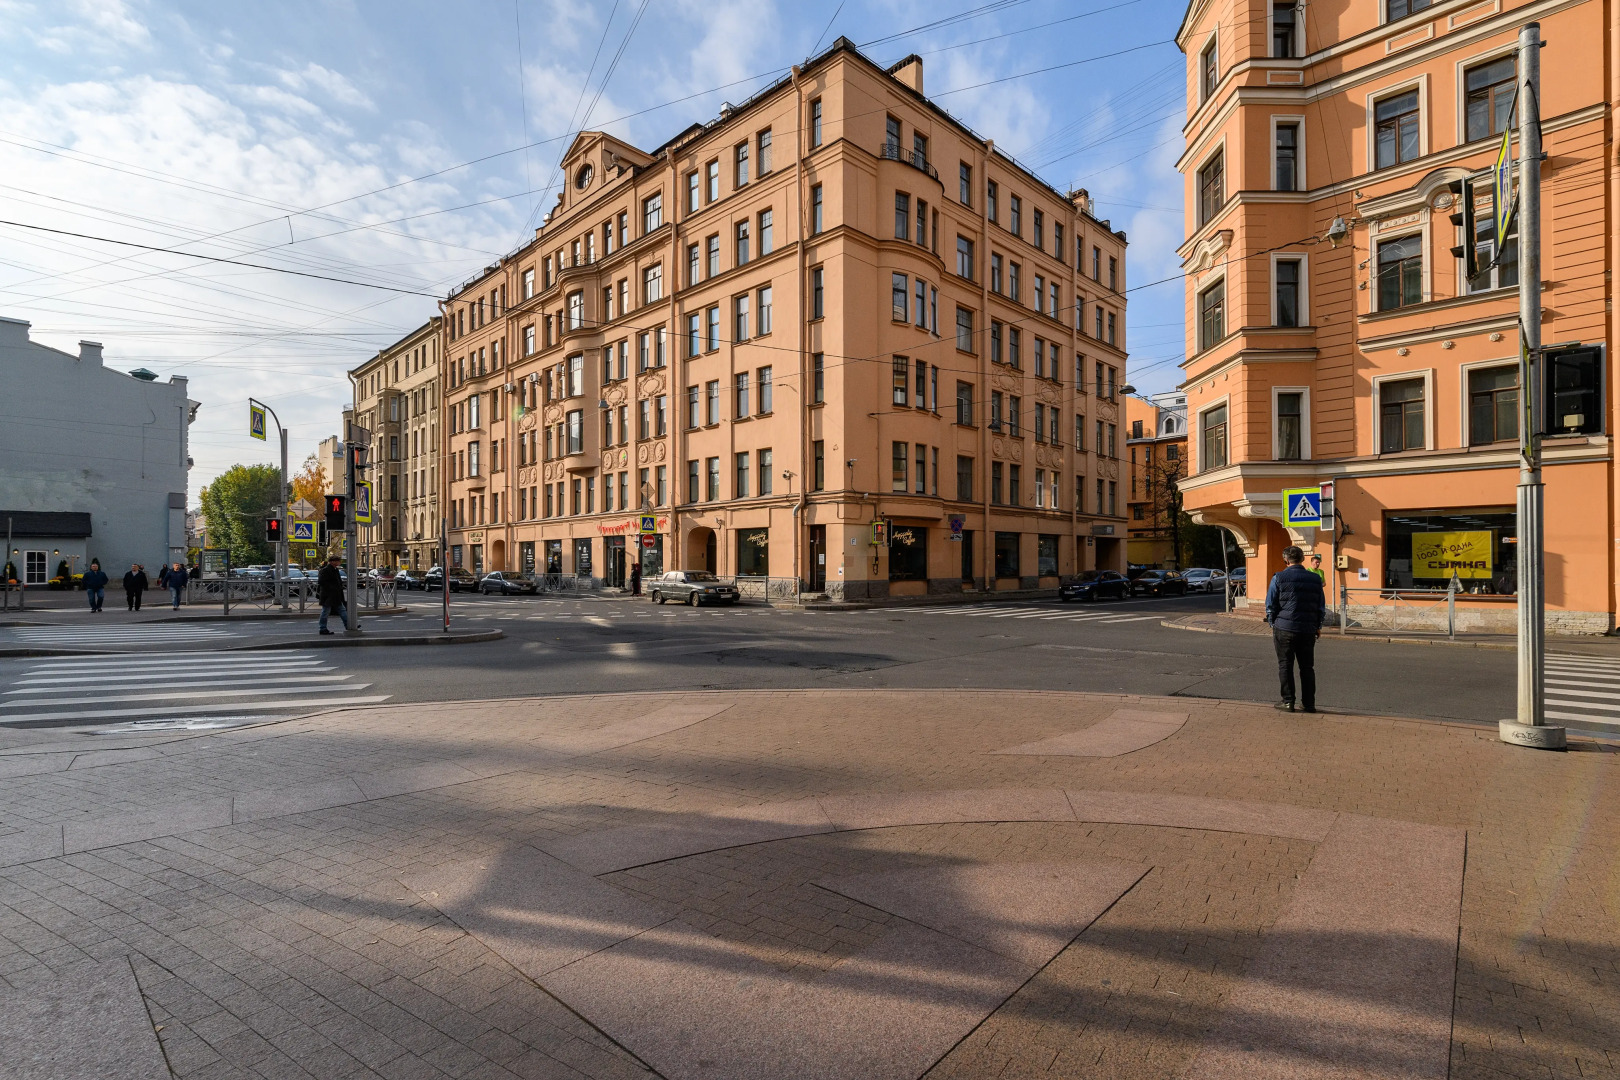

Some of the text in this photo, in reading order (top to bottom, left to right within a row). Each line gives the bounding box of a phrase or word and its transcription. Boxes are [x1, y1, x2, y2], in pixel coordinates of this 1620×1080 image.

[1416, 550, 1438, 560] 1000
[1449, 541, 1473, 552] ОДНА
[1428, 560, 1486, 569] СУМКА
